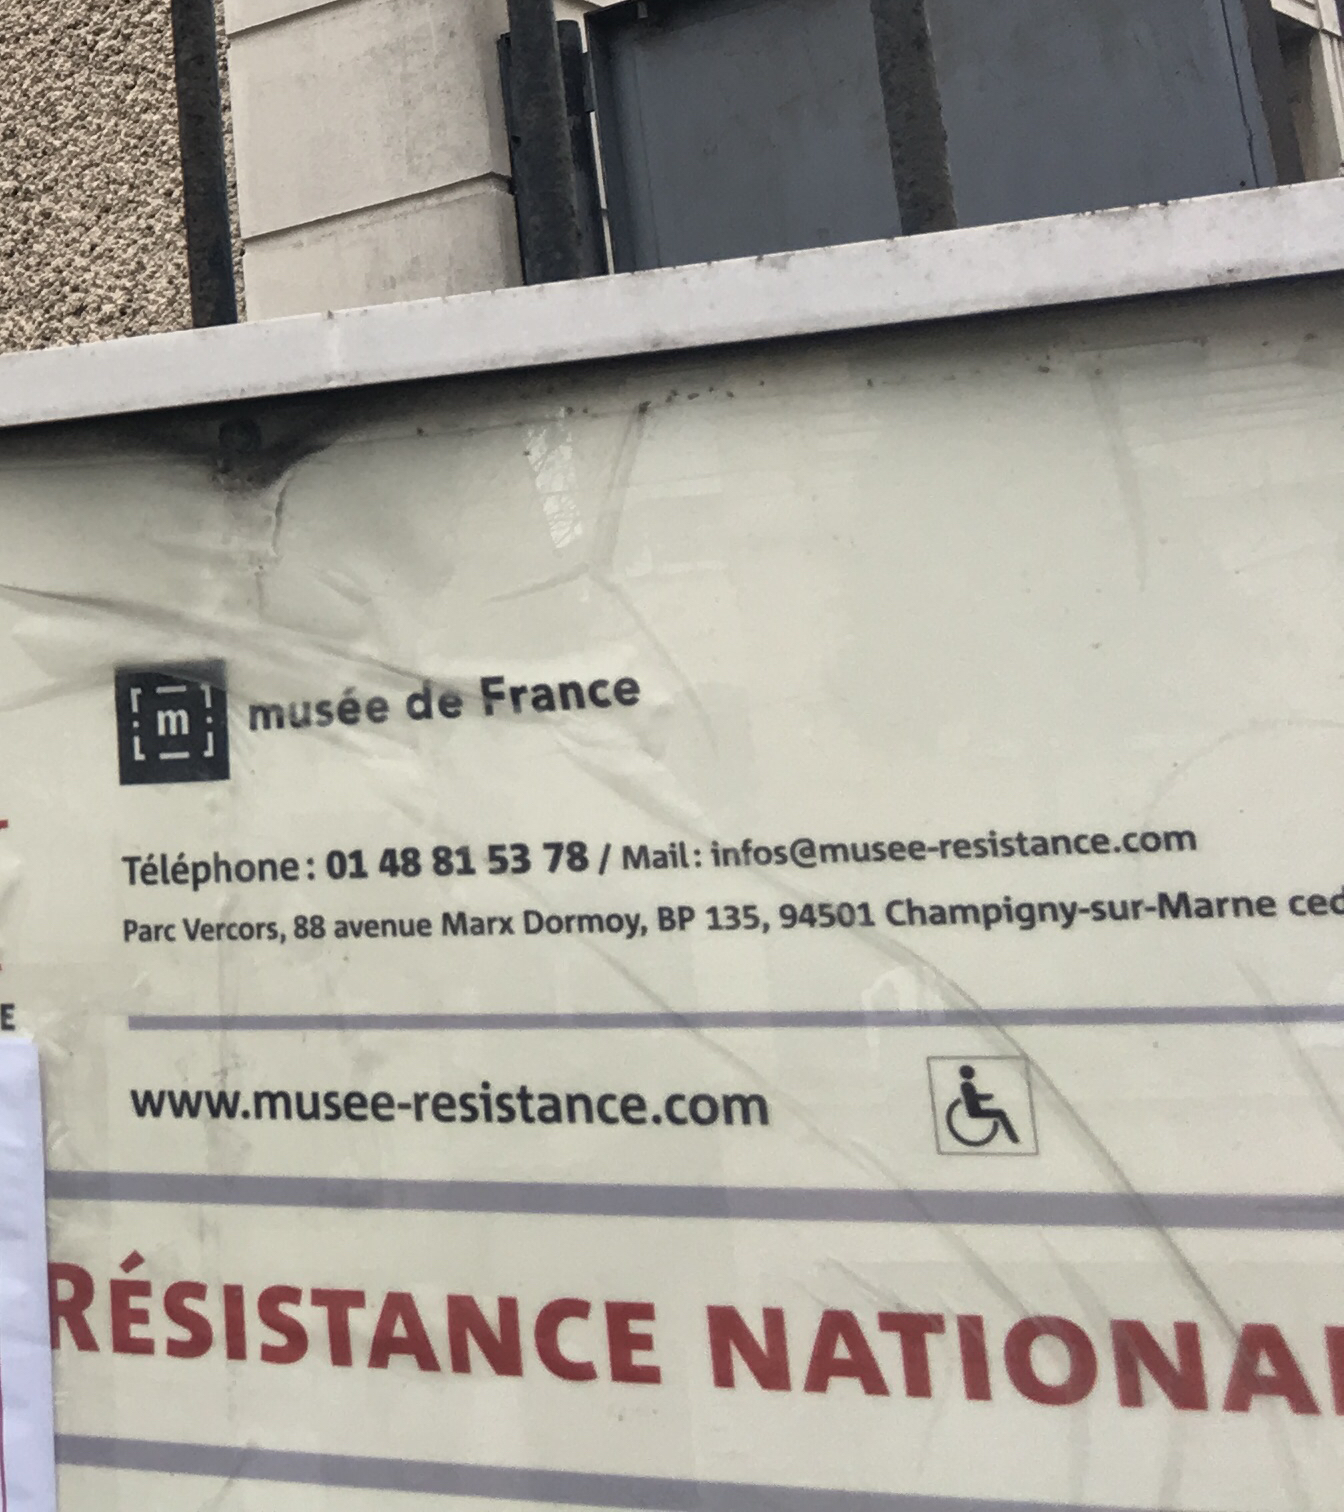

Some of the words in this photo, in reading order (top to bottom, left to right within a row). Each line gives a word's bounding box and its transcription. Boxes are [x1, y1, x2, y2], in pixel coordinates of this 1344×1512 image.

[248, 686, 389, 732] musée
[405, 678, 464, 721] de
[479, 672, 641, 717] France
[325, 849, 369, 881] 01
[378, 847, 422, 879] 48
[432, 845, 477, 877] 81
[487, 842, 531, 875] 53
[543, 841, 589, 874] 78
[598, 841, 612, 877] /
[711, 825, 1198, 870] infos@musee-resistance.com
[123, 917, 176, 944] Parc
[182, 916, 287, 945] Vercors,
[293, 914, 327, 940] 88
[334, 917, 432, 940] avenue
[441, 911, 514, 937] Marx
[523, 908, 648, 940] Dormoy,
[657, 905, 696, 932] BP
[706, 905, 771, 935] 135,
[779, 900, 875, 931] 94501
[884, 890, 1278, 932] Champigny-sur-Marne
[130, 1082, 769, 1126] www.musee-resistance.com
[47, 1249, 662, 1385] RÉSISTANCE
